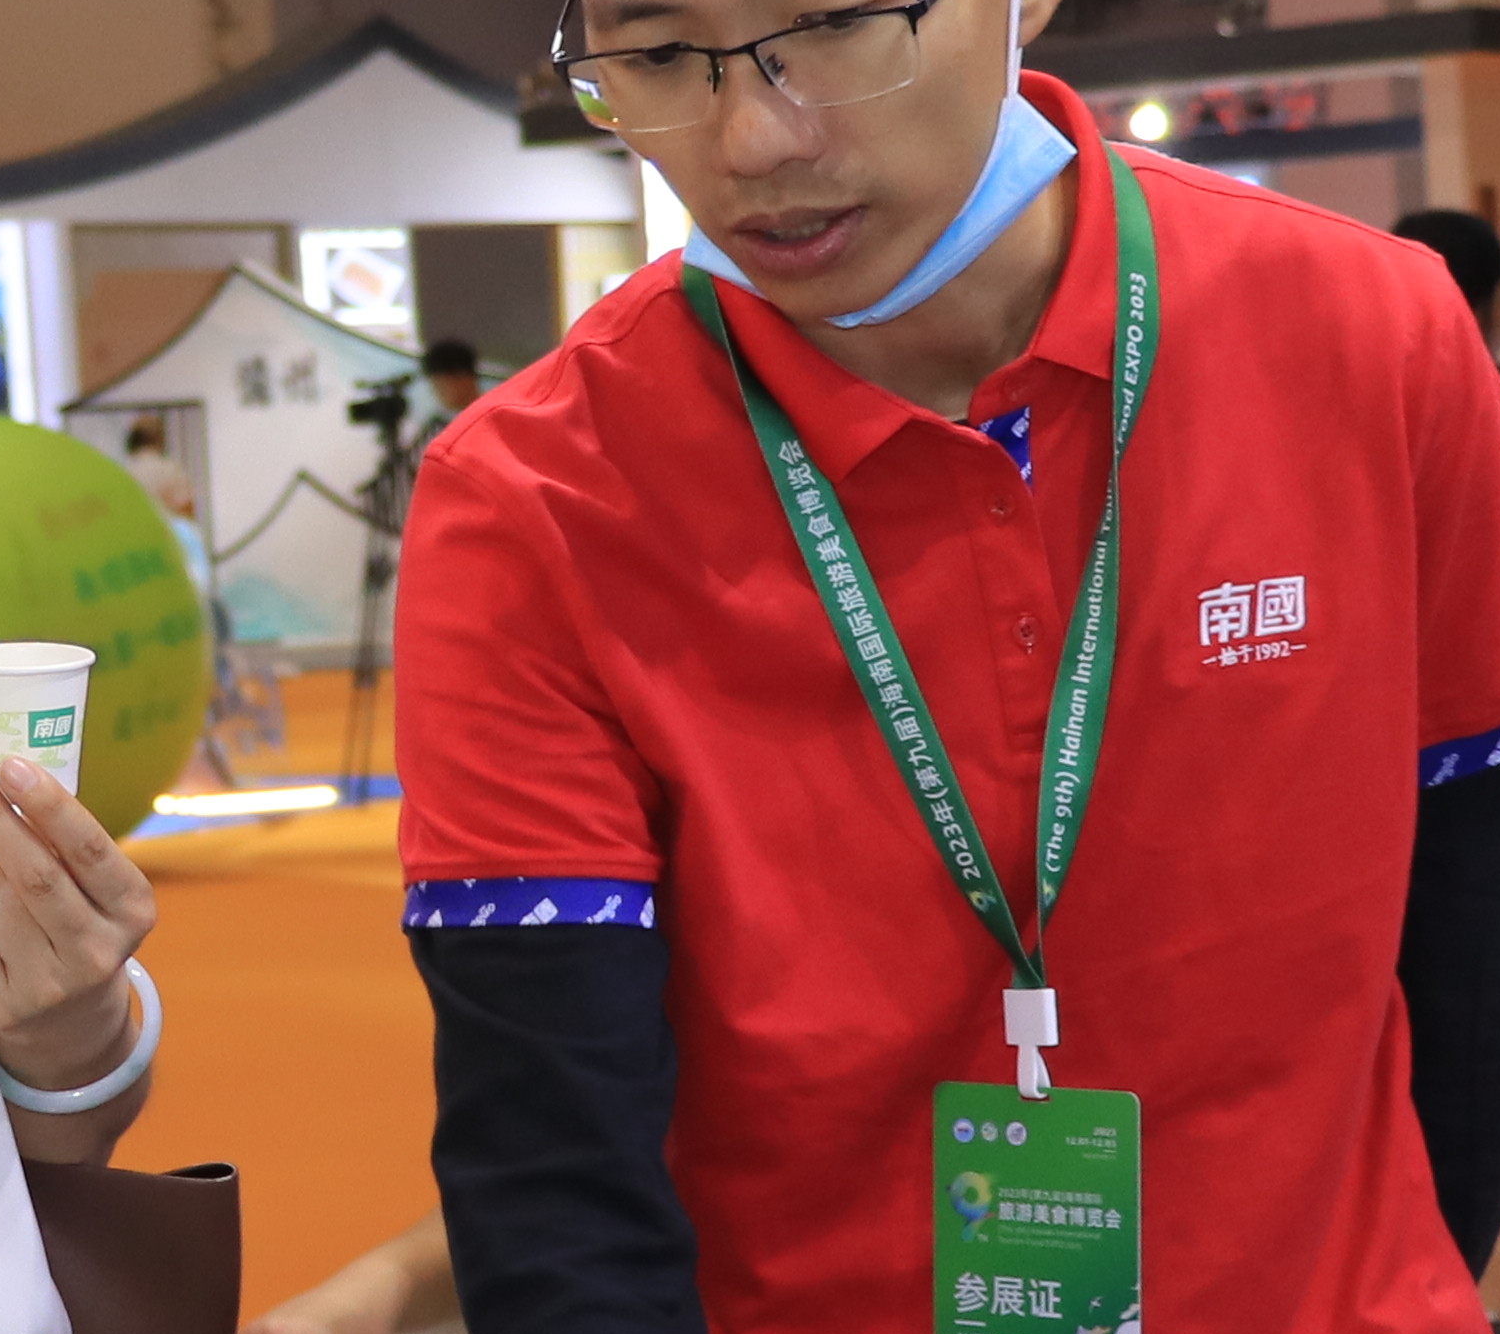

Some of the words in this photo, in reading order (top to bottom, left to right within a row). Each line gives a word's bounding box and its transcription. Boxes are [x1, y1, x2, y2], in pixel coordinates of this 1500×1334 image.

[1129, 272, 1147, 322] 2023
[1124, 325, 1145, 387] EXPO
[1070, 540, 1108, 685] International
[1059, 688, 1090, 767] Hainan
[1055, 770, 1081, 819] 9th)
[1044, 824, 1065, 873] (The
[999, 1201, 1122, 1230] 旅游美食博览会
[953, 1271, 1064, 1320] 参展证
